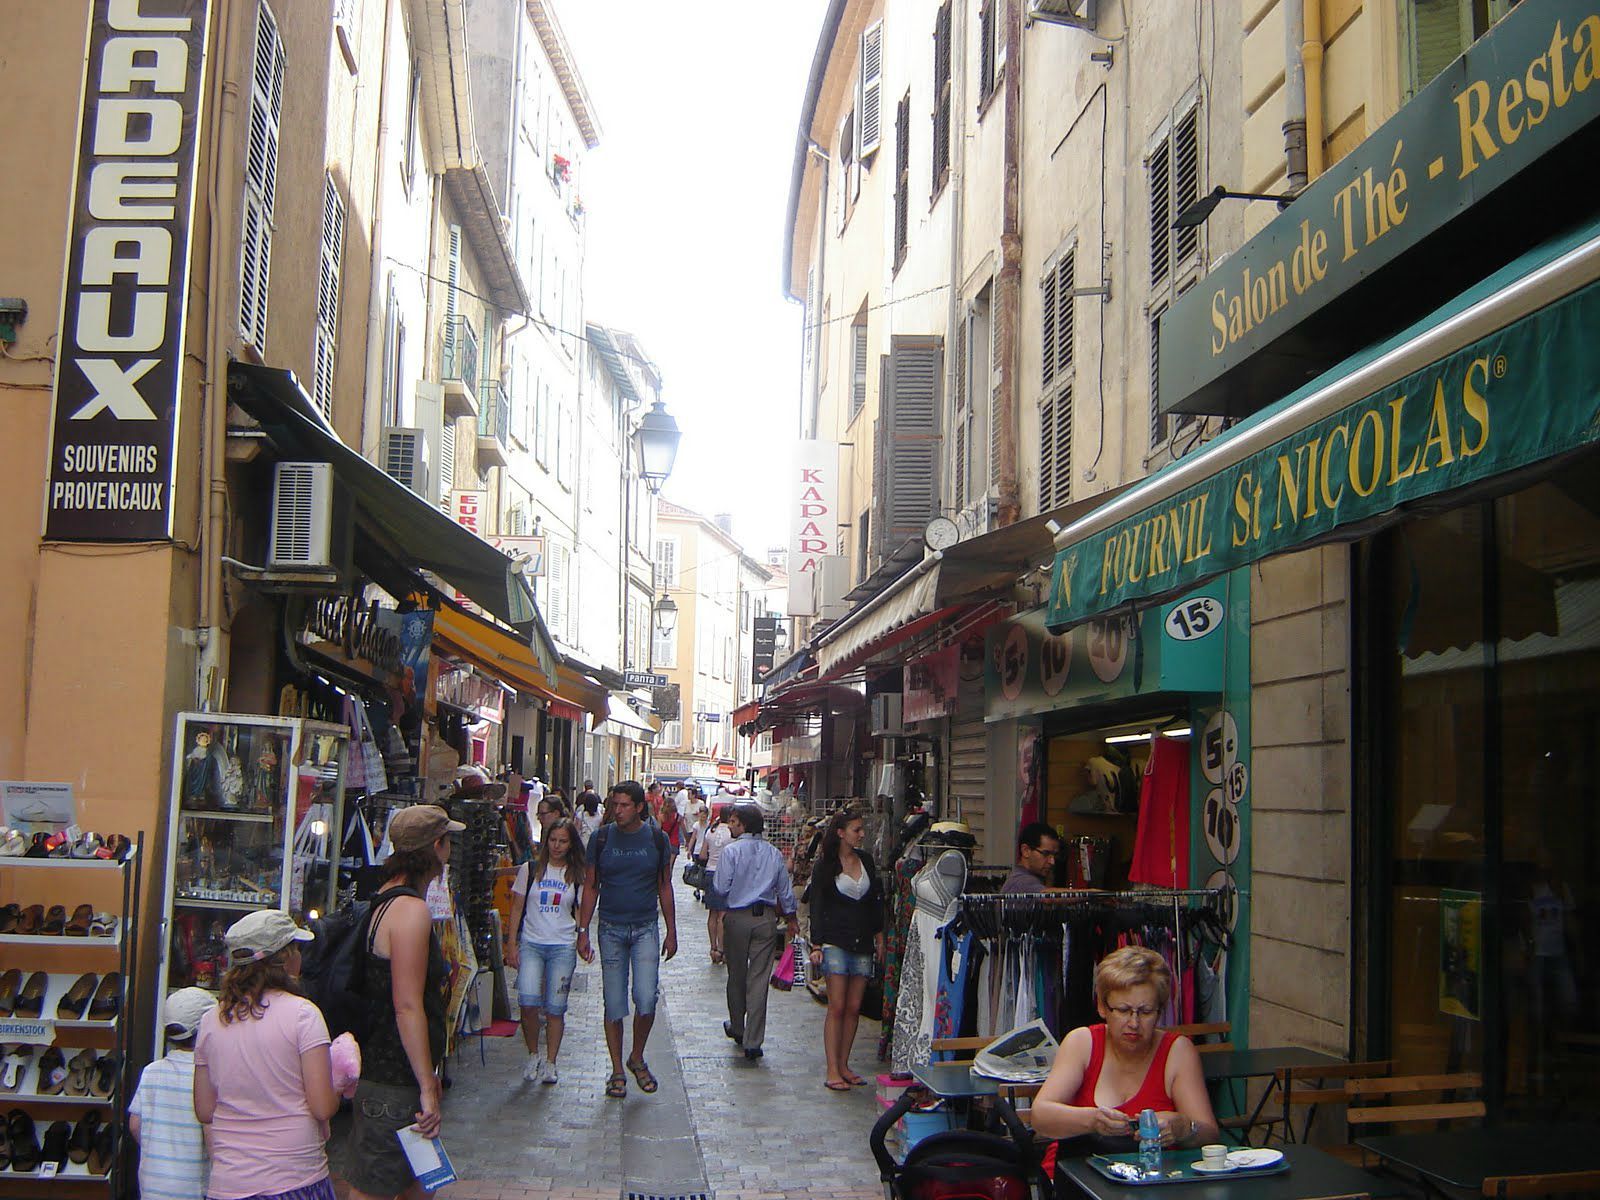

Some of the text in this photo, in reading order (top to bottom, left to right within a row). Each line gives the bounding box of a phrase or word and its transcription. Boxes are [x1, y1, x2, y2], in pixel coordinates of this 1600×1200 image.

[1212, 268, 1289, 357] Salon
[1292, 219, 1328, 296] de
[1333, 139, 1408, 264] Thé
[63, 445, 158, 473] SOUVENIRS
[53, 482, 163, 510] PROVENCAUX
[798, 468, 828, 573] KAPARA
[1099, 493, 1212, 595] FOURNIL
[1232, 473, 1262, 548] St
[1172, 599, 1213, 638] 15€
[538, 879, 568, 892] FRANCE
[540, 905, 560, 914] 2010
